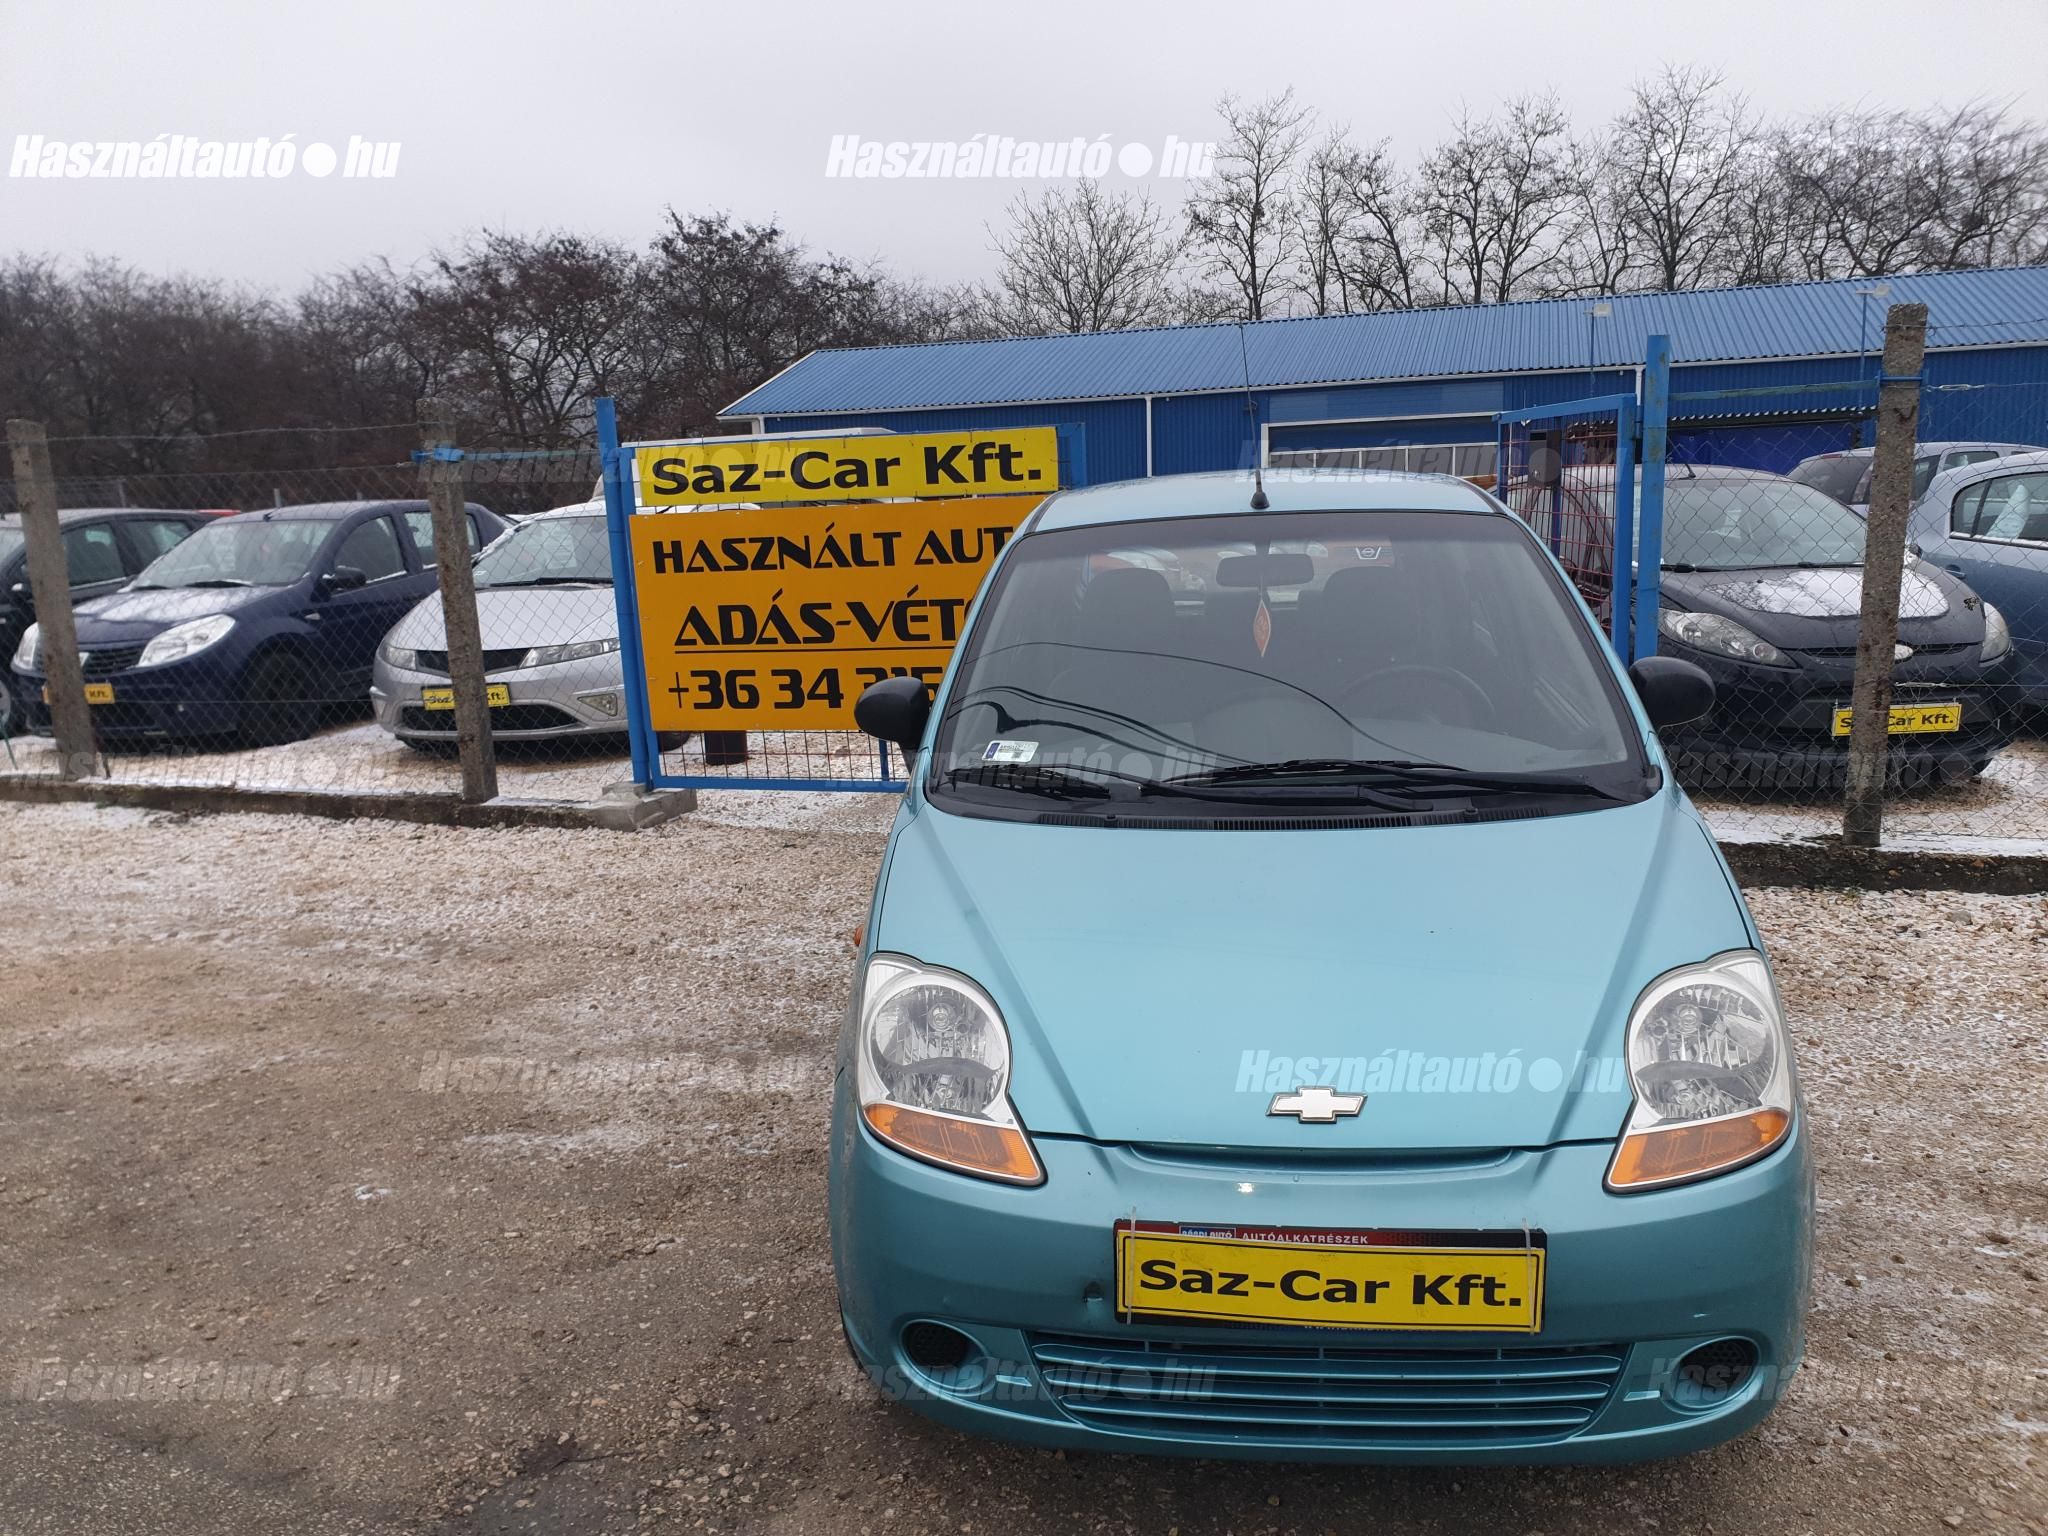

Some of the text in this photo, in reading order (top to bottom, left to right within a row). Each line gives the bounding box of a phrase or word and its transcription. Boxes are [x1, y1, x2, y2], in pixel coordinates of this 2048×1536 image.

[653, 441, 1043, 494] Saz-Car Kft.
[653, 522, 1014, 574] HASZNÁLT AUT
[674, 585, 976, 646] ADÁS-VÉT
[668, 668, 760, 710] +36
[771, 668, 845, 710] 34
[1921, 713, 1954, 725] Kft.
[1242, 1231, 1369, 1245] AUTÓALKATRÉSZEK
[1139, 1259, 1522, 1307] Saz-Car Kft.
